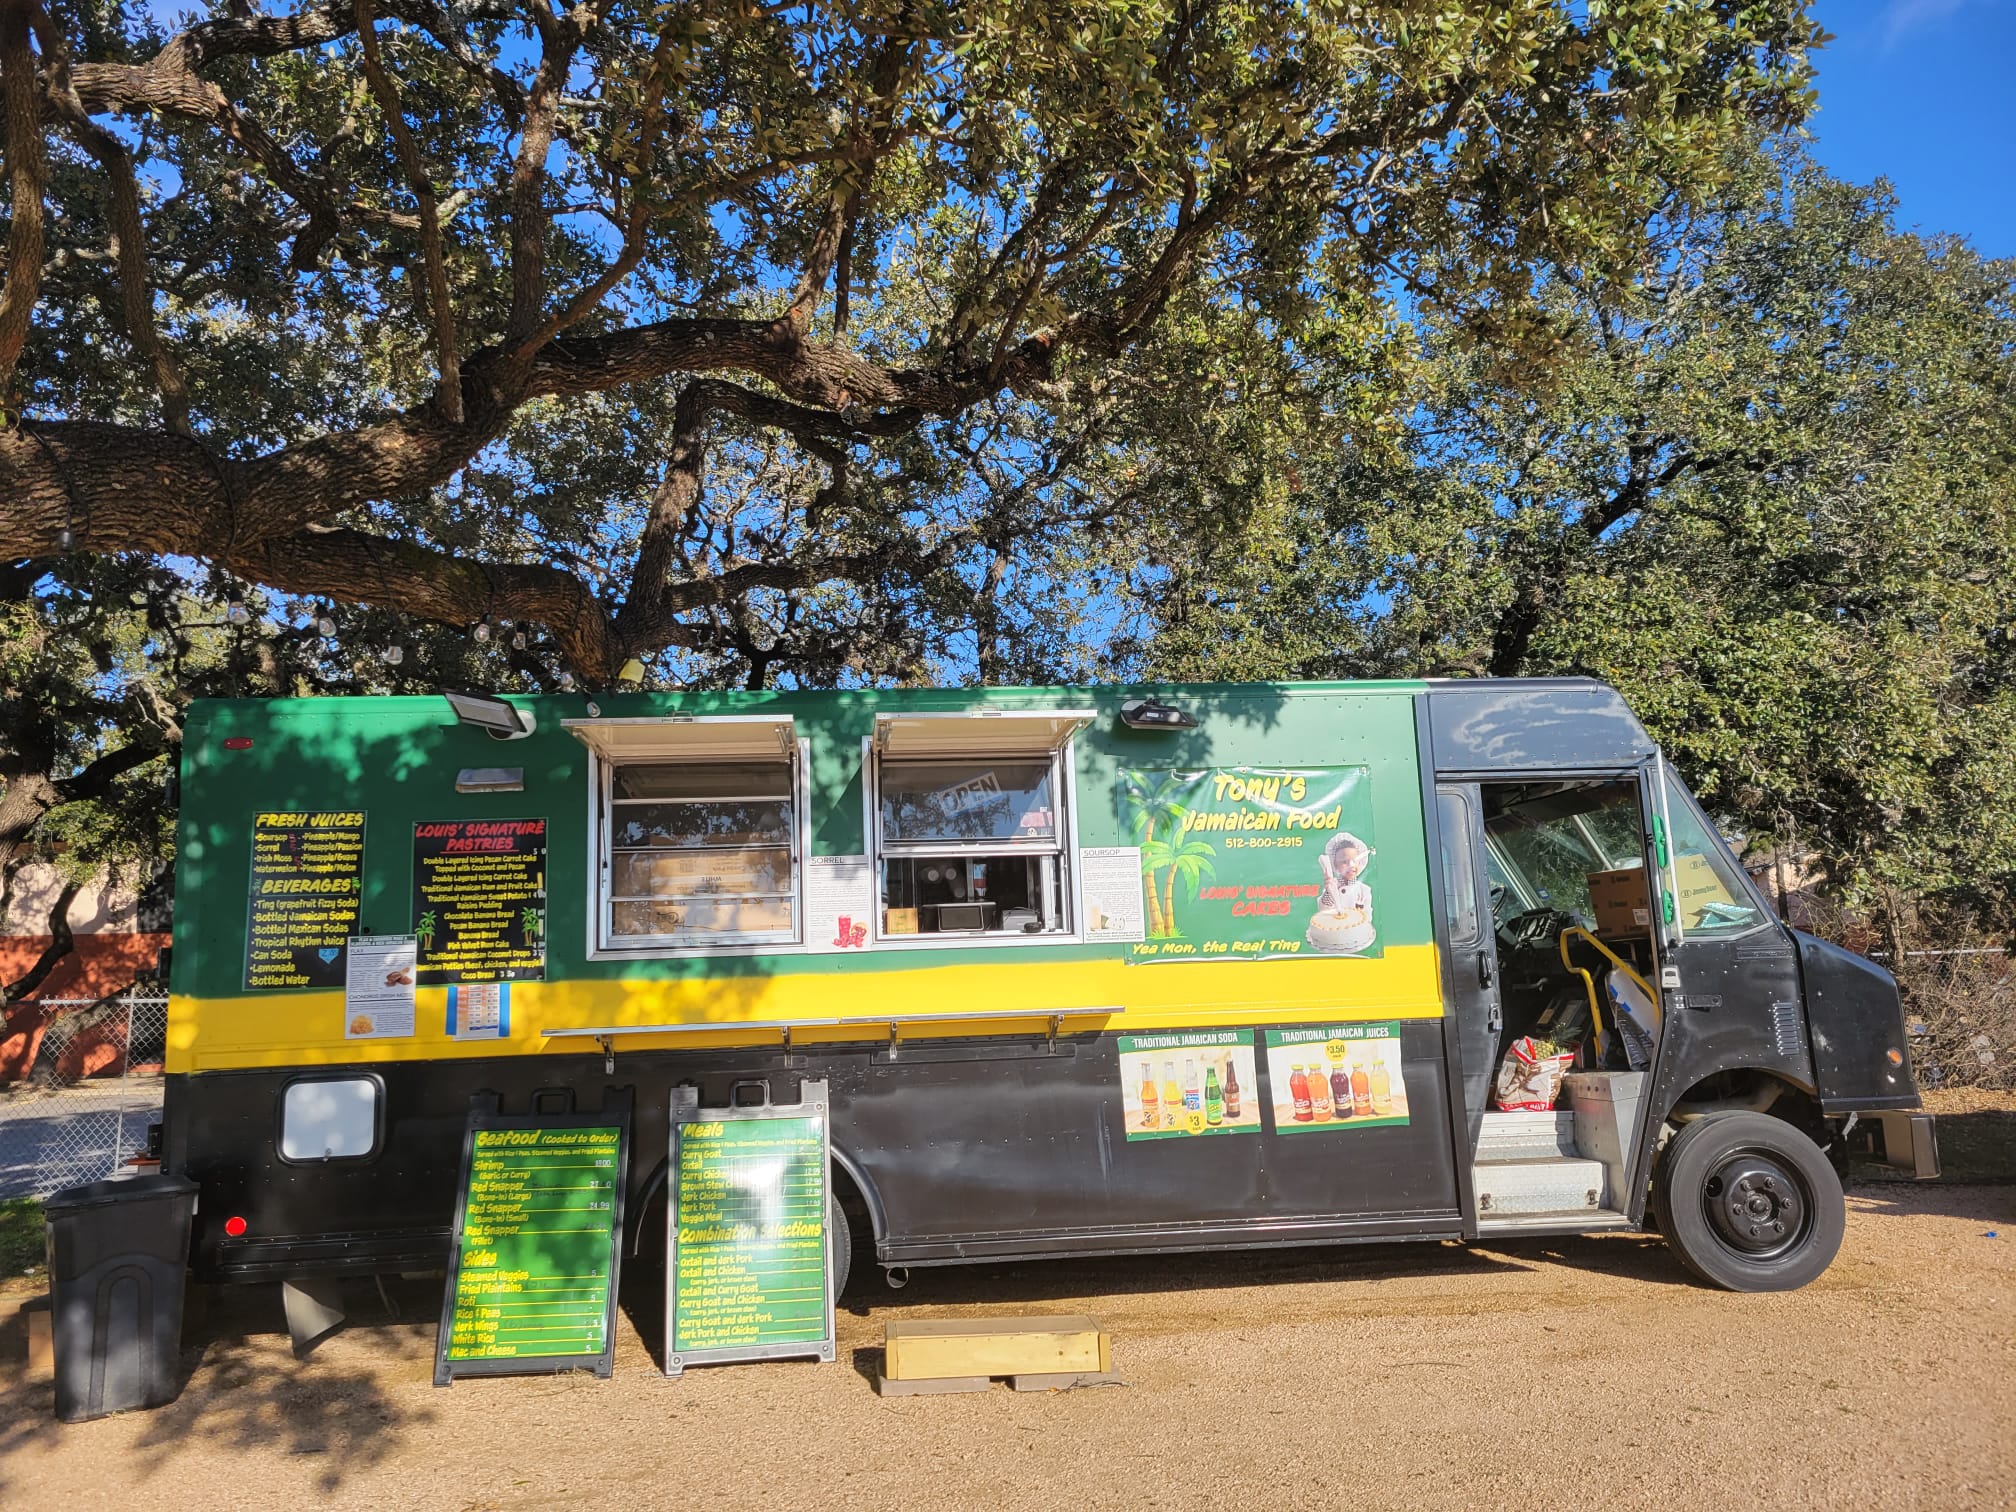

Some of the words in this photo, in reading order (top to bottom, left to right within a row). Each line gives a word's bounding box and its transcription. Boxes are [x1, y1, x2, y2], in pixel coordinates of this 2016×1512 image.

[942, 775, 998, 811] OPEN
[1214, 773, 1306, 803] Tony's
[256, 813, 308, 827] FRESH
[310, 812, 364, 827] JUICES
[1181, 809, 1280, 833] Jamaican
[1286, 805, 1342, 830] Food
[415, 824, 463, 837] LOUIS'
[465, 821, 545, 836] SIGNATURE
[446, 837, 514, 851] PASTRIES
[1225, 836, 1303, 849] 512-800-2915
[256, 854, 272, 863] Irish
[274, 854, 292, 862] Moss
[1083, 849, 1120, 857] SOURSOP
[811, 856, 844, 864] SORREL
[261, 878, 351, 894] BEVERAGES
[257, 899, 275, 910] Ting
[337, 897, 358, 908] Soda)
[1231, 901, 1291, 917] CAKES
[255, 911, 288, 922] Bottled
[289, 910, 328, 921] Jamaican
[329, 910, 356, 920] Sodas
[255, 924, 287, 934] Bottled
[288, 923, 321, 934] Mexican
[322, 922, 349, 933] Sodas
[254, 936, 287, 948] Tropical
[289, 936, 321, 948] Rhythm
[323, 935, 345, 946] Juice
[1132, 943, 1158, 955] Yea
[1162, 943, 1197, 955] Mon,
[1202, 941, 1226, 952] the
[1232, 940, 1264, 952] Real
[1270, 940, 1300, 952] Ting
[253, 950, 269, 960] Can
[270, 949, 293, 960] Soda
[252, 962, 296, 973] Lemonade
[251, 974, 284, 985] Bottled
[286, 974, 310, 985] Water
[1133, 1036, 1180, 1048] TRADITIONAL
[1181, 1034, 1217, 1045] JAMAICAN
[1218, 1032, 1238, 1043] SODA
[1281, 1030, 1327, 1042] TRADITIONAL
[1328, 1028, 1363, 1040] JAMAICAN
[1366, 1027, 1389, 1038] JUICES
[1326, 1044, 1345, 1054] $3.50
[1189, 1115, 1200, 1126] $3
[683, 1122, 724, 1137] Meals
[477, 1129, 541, 1146] Seafood
[541, 1134, 577, 1144] (Cooked
[578, 1134, 588, 1143] to
[589, 1133, 618, 1143] Order)
[682, 1151, 702, 1160] Curry
[703, 1149, 721, 1159] Goat
[474, 1160, 504, 1172] Shrimp
[682, 1160, 702, 1170] Oxtail
[682, 1171, 702, 1181] Curry
[471, 1181, 488, 1192] Red
[489, 1182, 524, 1193] Snapper
[681, 1182, 705, 1191] Brown
[706, 1181, 724, 1190] Stew
[681, 1193, 697, 1202] Jerk
[700, 1192, 726, 1201] Chicken
[469, 1203, 486, 1214] Red
[486, 1204, 522, 1215] Snapper
[681, 1203, 697, 1212] Jerk
[699, 1203, 716, 1211] Pork
[681, 1214, 704, 1224] Veggie
[705, 1212, 722, 1221] Meal
[466, 1225, 483, 1236] Red
[483, 1226, 520, 1236] Snapper
[678, 1225, 757, 1244] Combination
[760, 1221, 822, 1239] Selections
[463, 1249, 497, 1267] Sides
[680, 1256, 702, 1267] Oxtail
[703, 1256, 717, 1266] and
[718, 1255, 735, 1266] Jerk
[735, 1254, 752, 1263] Pork
[461, 1270, 497, 1282] Steamed
[498, 1270, 529, 1282] Veggies
[680, 1267, 702, 1278] Oxtail
[703, 1267, 717, 1277] and
[717, 1265, 746, 1275] Chicken
[459, 1282, 481, 1294] Fried
[680, 1287, 702, 1297] Oxtail
[703, 1286, 717, 1296] and
[717, 1285, 739, 1295] Curry
[740, 1283, 759, 1293] Goat
[457, 1295, 476, 1307] Roti
[679, 1299, 702, 1309] Curry
[702, 1298, 721, 1308] Goat
[722, 1297, 736, 1306] and
[737, 1295, 766, 1305] Chicken
[456, 1308, 474, 1319] Rice
[480, 1308, 501, 1318] Peas
[454, 1320, 474, 1332] Jerk
[475, 1320, 499, 1332] Wings
[679, 1318, 701, 1328] Curry
[702, 1317, 721, 1327] Goat
[722, 1315, 736, 1325] and
[737, 1314, 755, 1324] Jerk
[755, 1312, 773, 1323] Pork
[452, 1333, 476, 1344] White
[477, 1333, 496, 1344] Rice
[678, 1329, 696, 1340] Jerk
[697, 1328, 715, 1338] Pork
[716, 1327, 731, 1337] and
[731, 1325, 760, 1335] Chicken
[450, 1346, 468, 1357] Mac
[470, 1345, 486, 1356] and
[487, 1344, 517, 1356] Cheese
